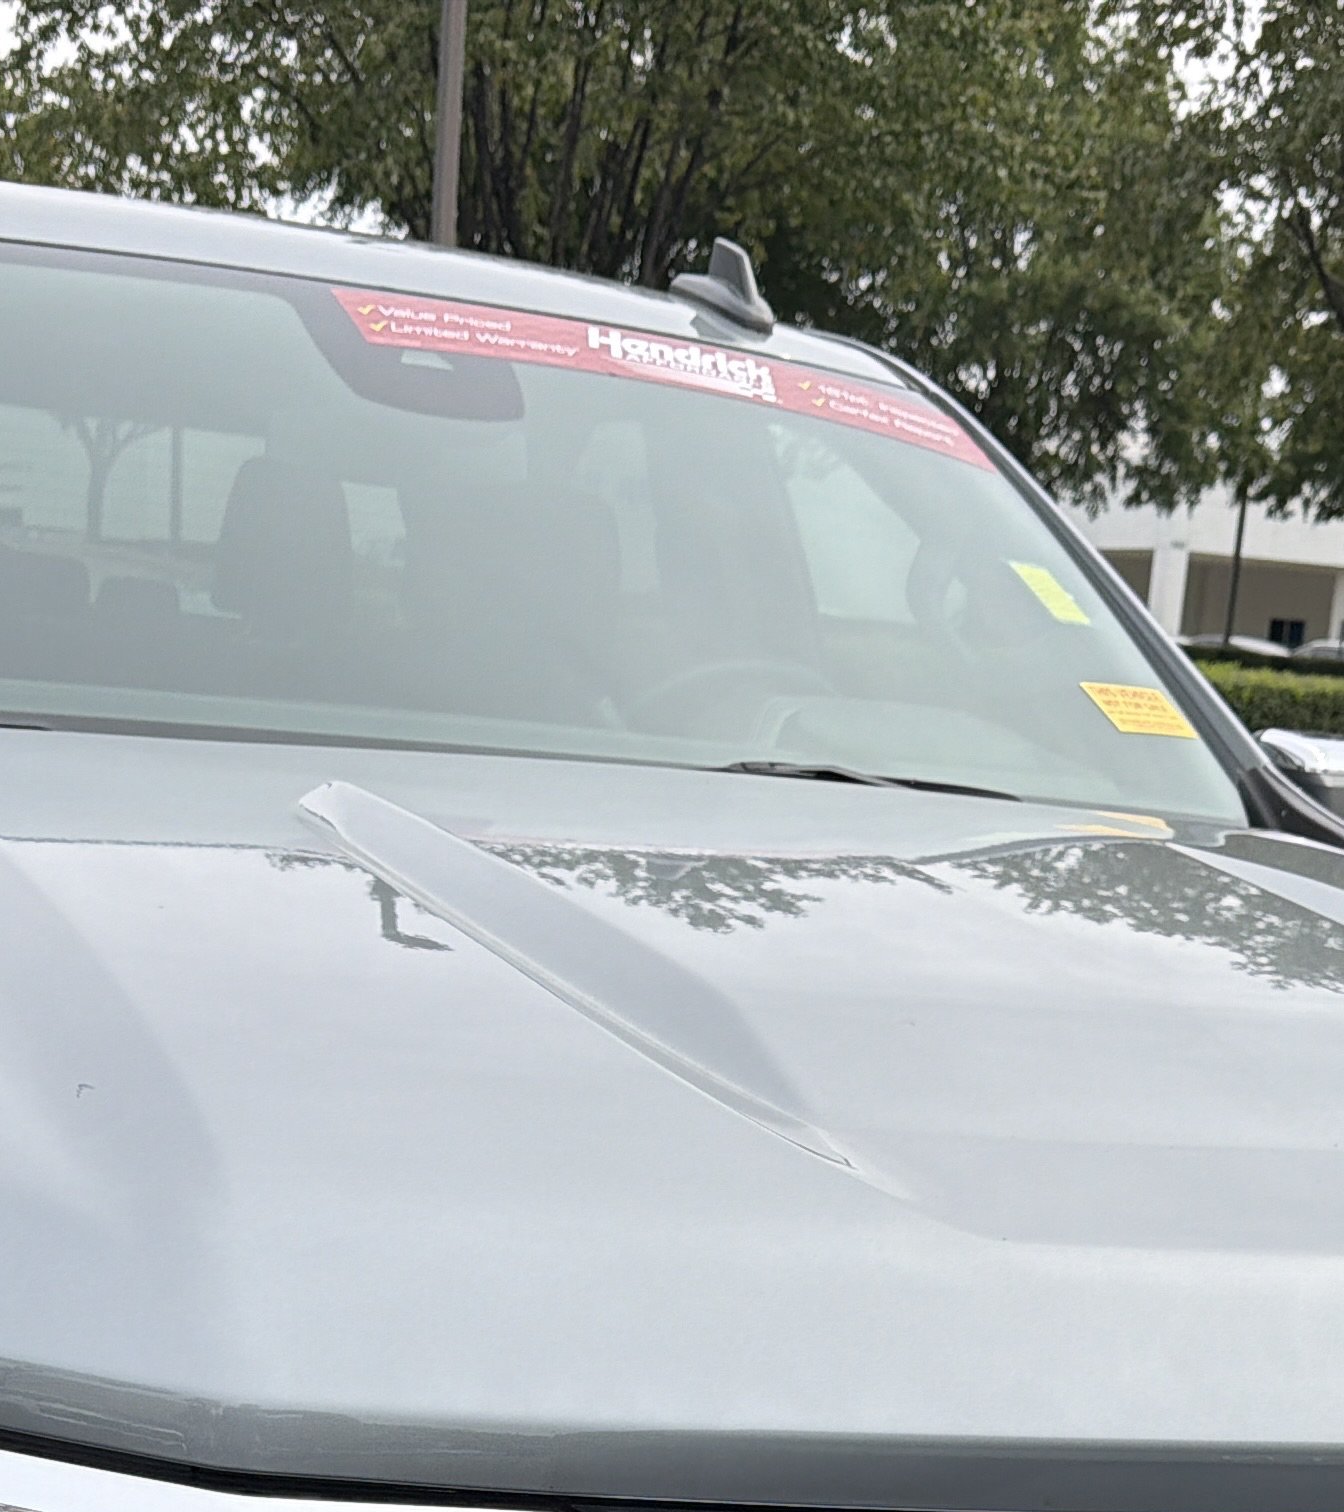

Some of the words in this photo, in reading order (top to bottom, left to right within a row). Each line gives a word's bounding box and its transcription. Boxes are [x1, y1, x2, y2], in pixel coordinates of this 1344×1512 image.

[390, 321, 469, 341] Limited
[475, 332, 578, 357] Warranty
[587, 326, 775, 390] Hendrick
